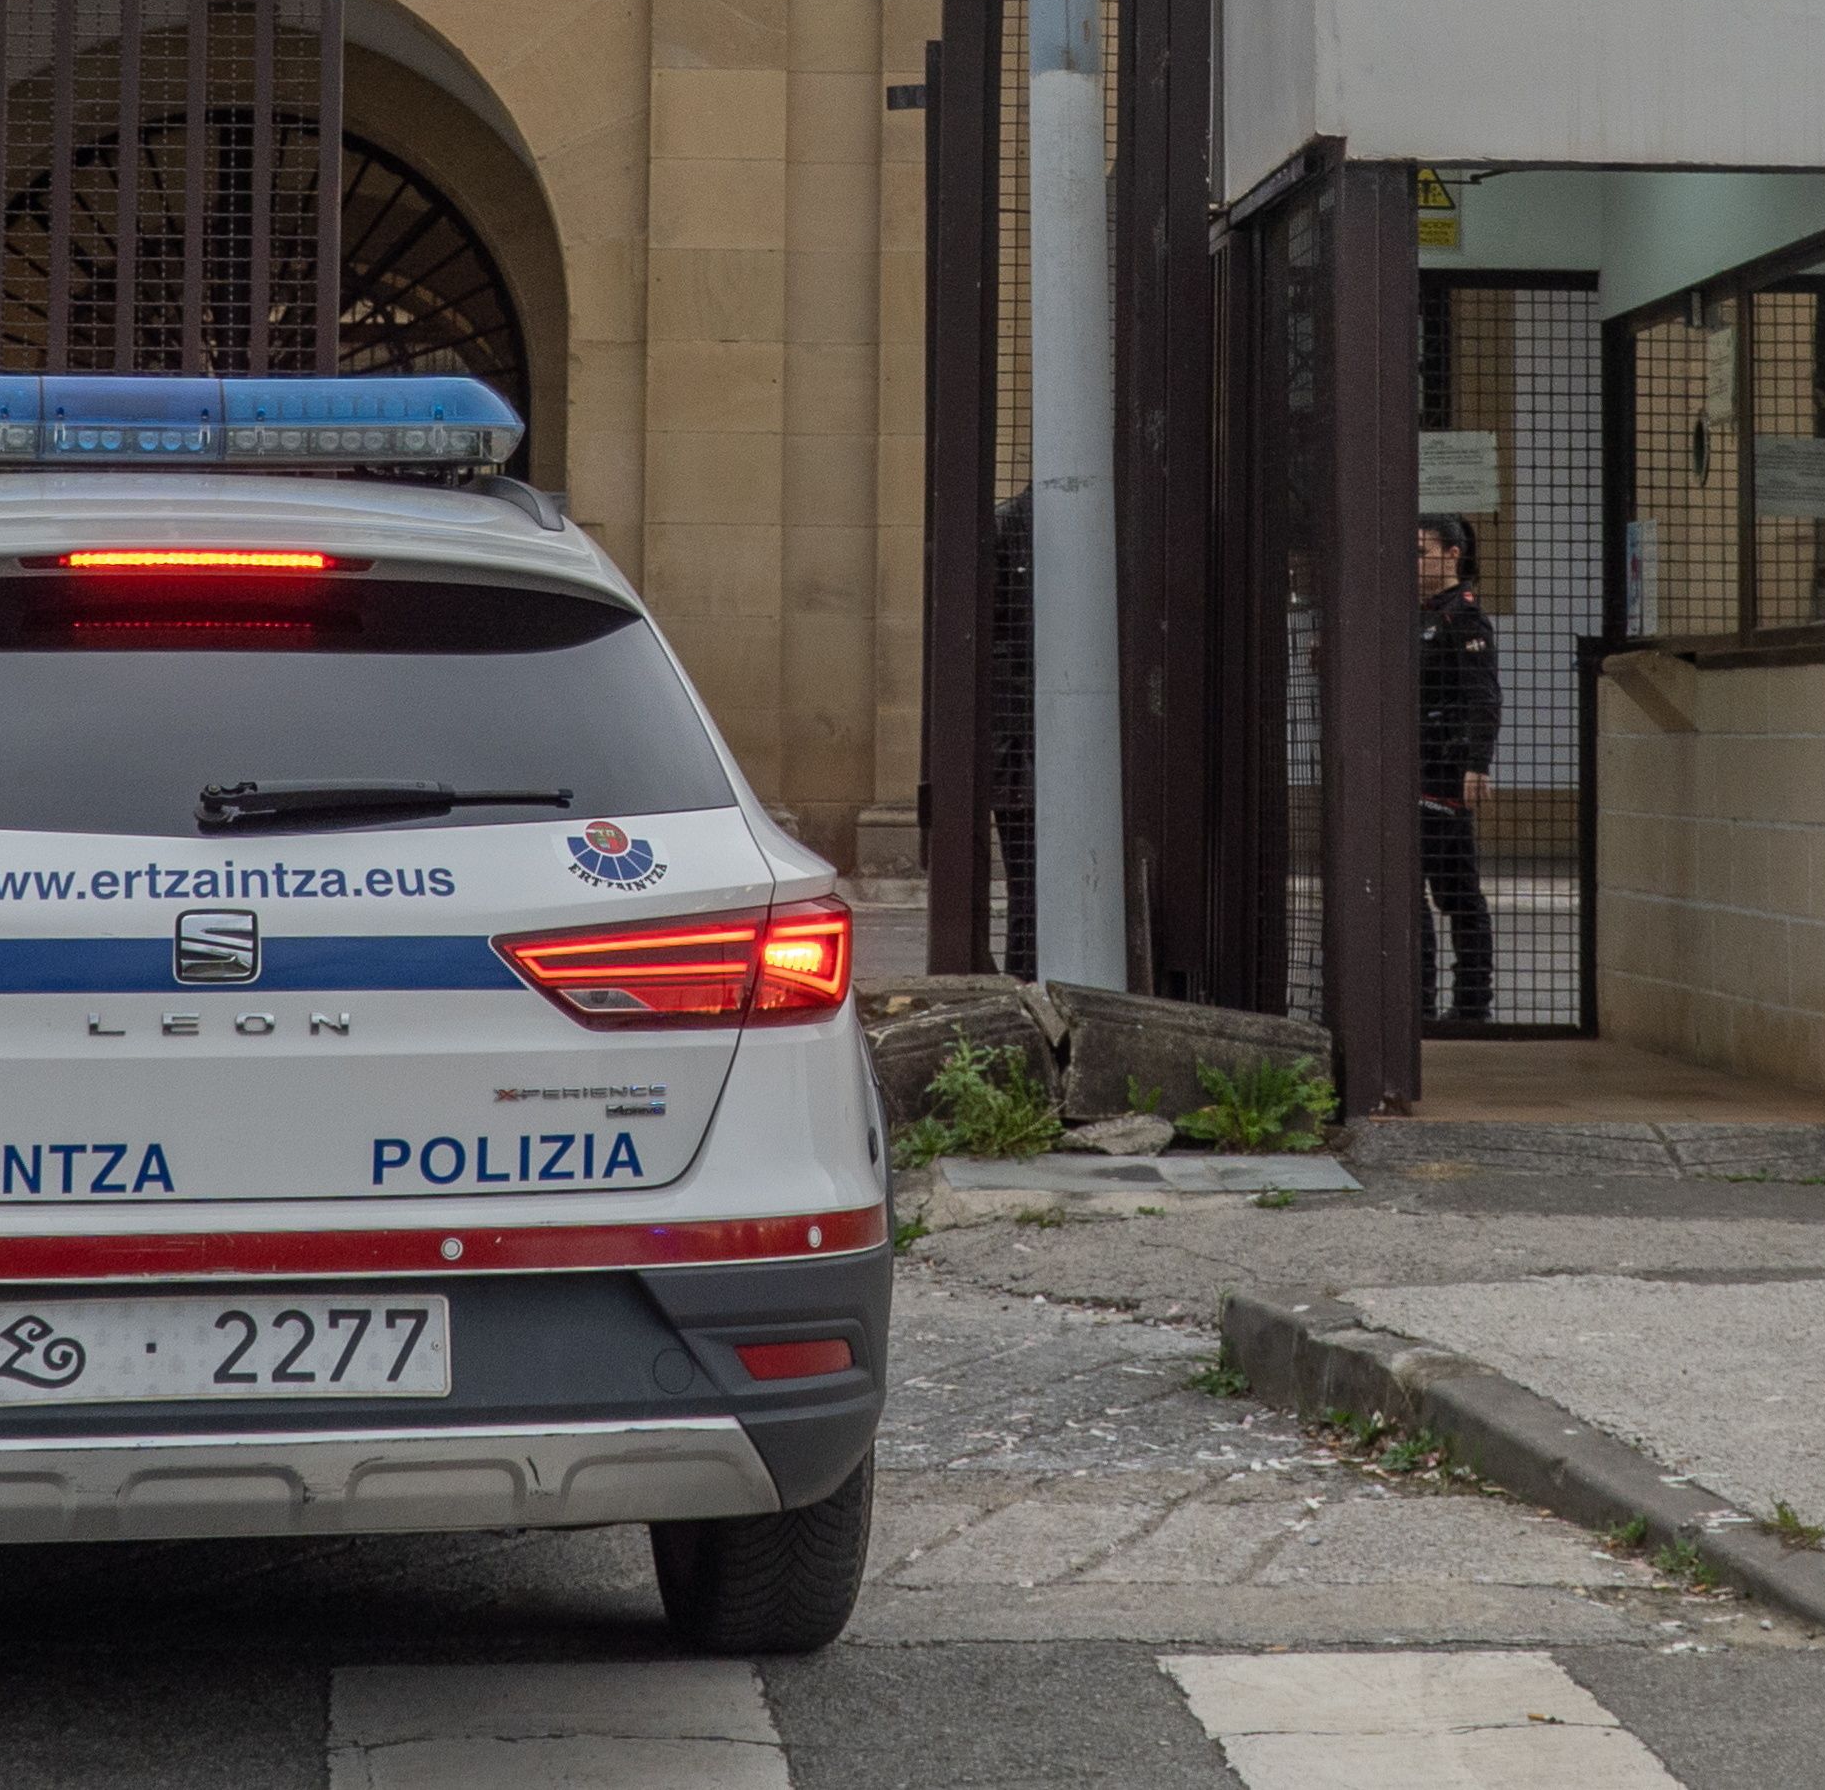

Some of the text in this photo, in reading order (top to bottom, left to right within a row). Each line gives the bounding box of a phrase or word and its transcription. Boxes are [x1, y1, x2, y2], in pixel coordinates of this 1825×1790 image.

[88, 1012, 350, 1036] LEON
[372, 1131, 644, 1186] POLIZIA
[212, 1309, 429, 1384] 2277
